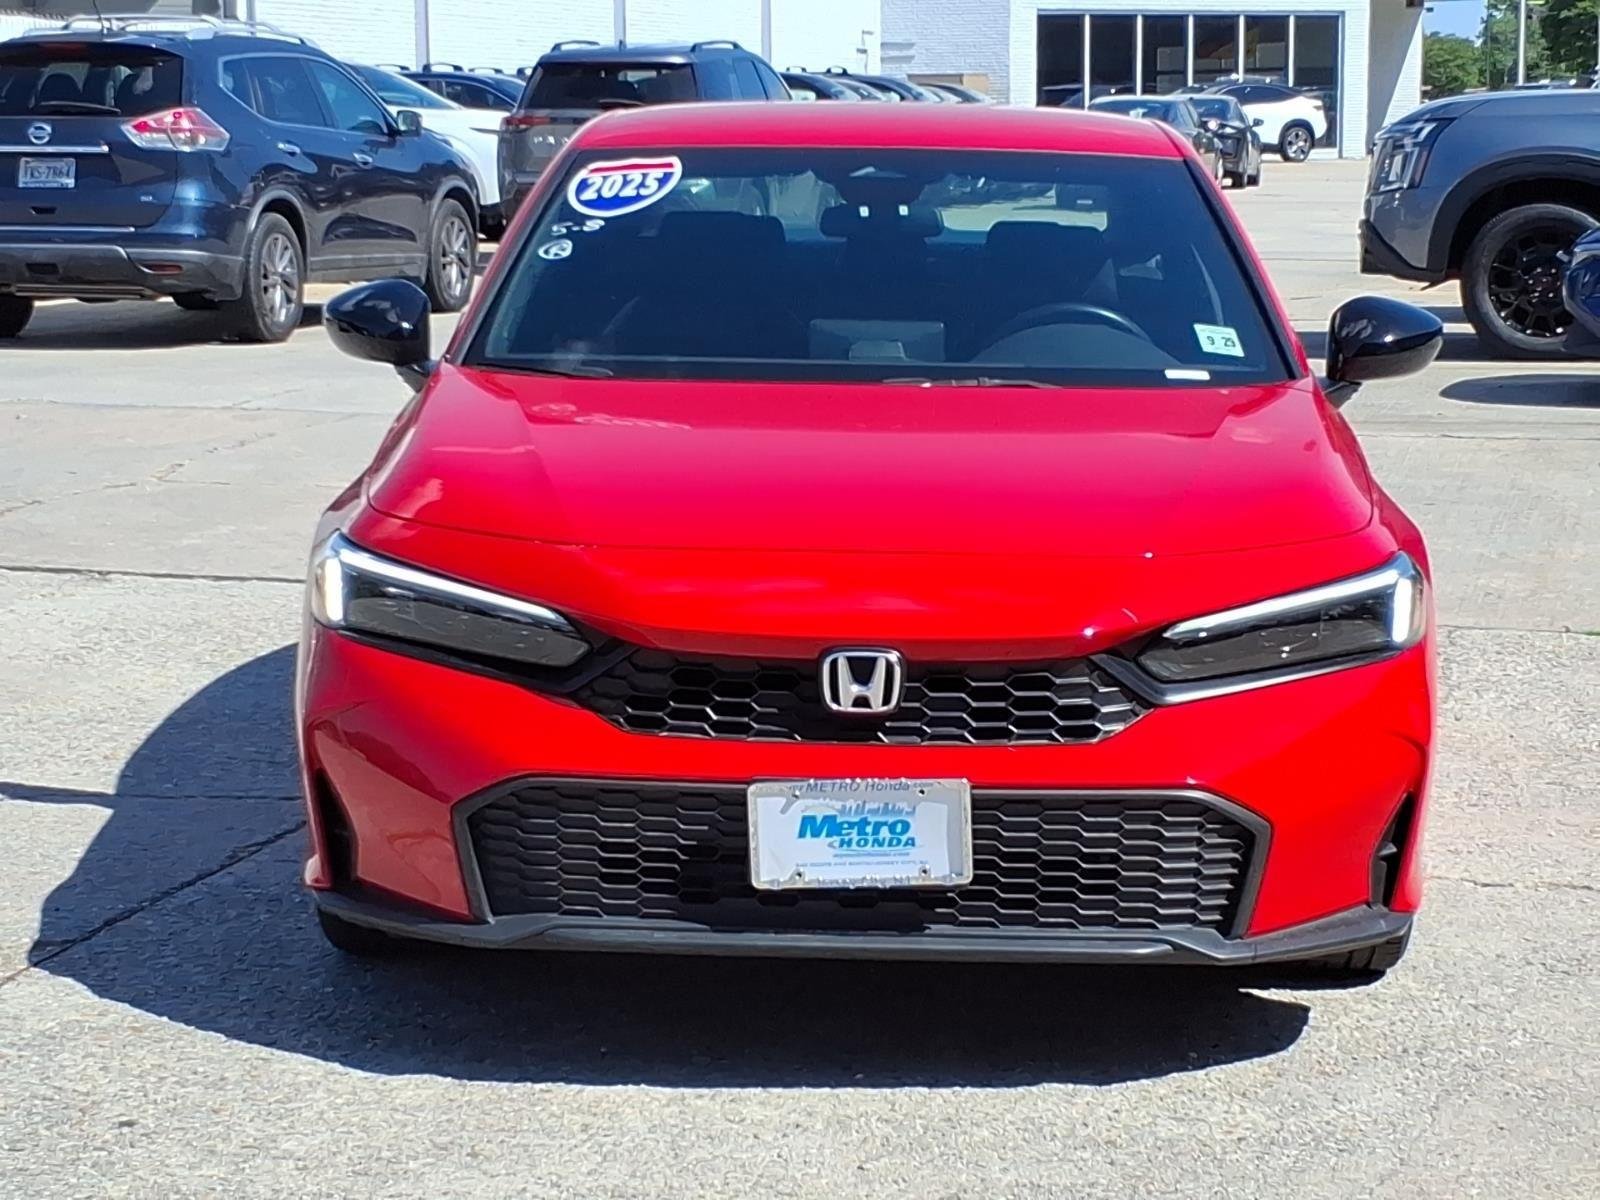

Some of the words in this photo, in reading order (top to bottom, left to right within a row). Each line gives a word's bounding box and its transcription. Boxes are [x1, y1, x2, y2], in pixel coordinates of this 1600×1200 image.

[579, 172, 664, 201] 2025
[805, 781, 861, 793] METRO
[864, 780, 910, 793] Honda
[797, 813, 911, 839] Metro
[838, 836, 917, 848] HONDA
